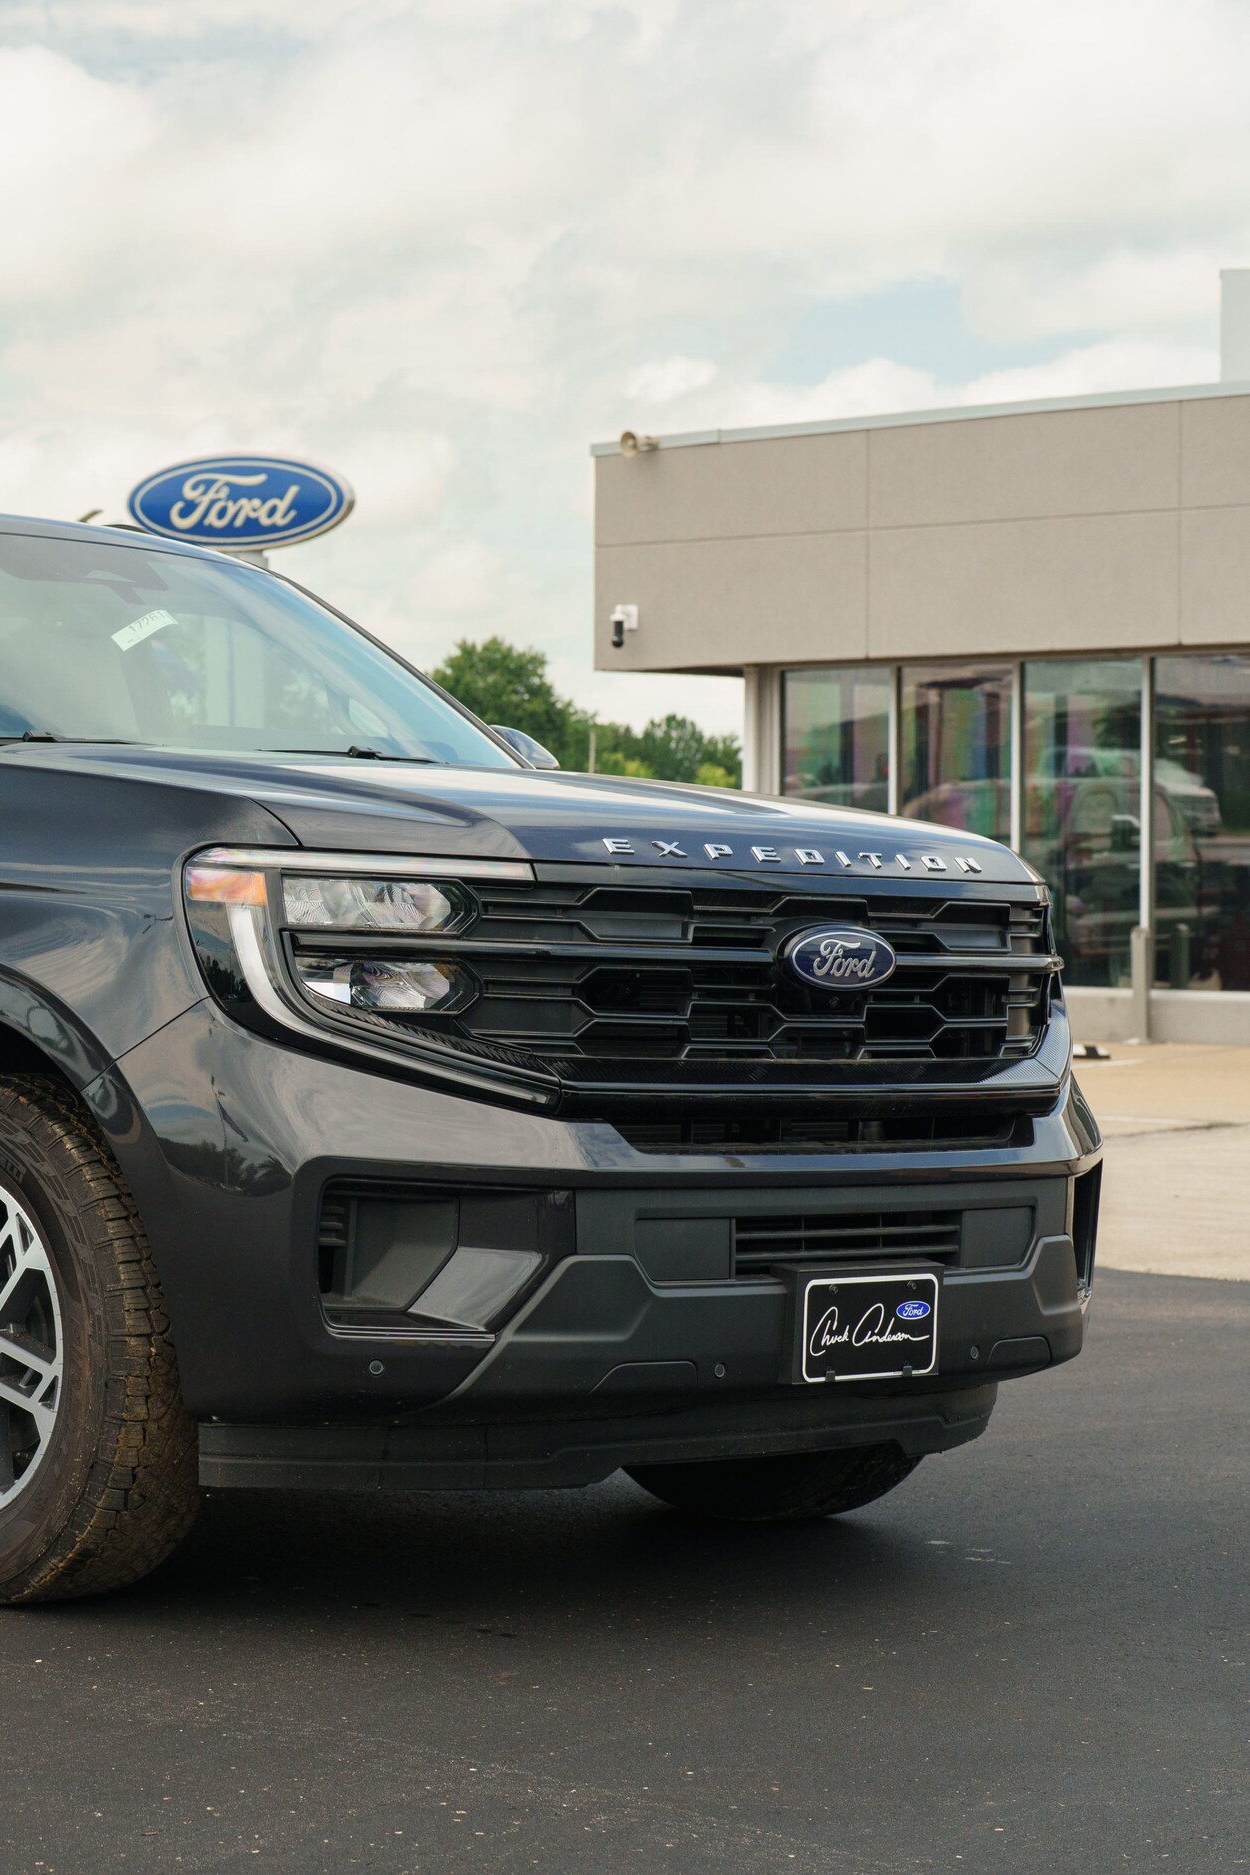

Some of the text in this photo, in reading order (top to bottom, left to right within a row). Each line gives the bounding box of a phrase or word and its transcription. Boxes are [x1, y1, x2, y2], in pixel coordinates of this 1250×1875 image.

[169, 472, 300, 530] Ford
[601, 837, 984, 874] EXPEDITION
[813, 938, 877, 979] Ford
[809, 1303, 930, 1357] Chuck Anderson
[901, 1303, 924, 1316] Ford
